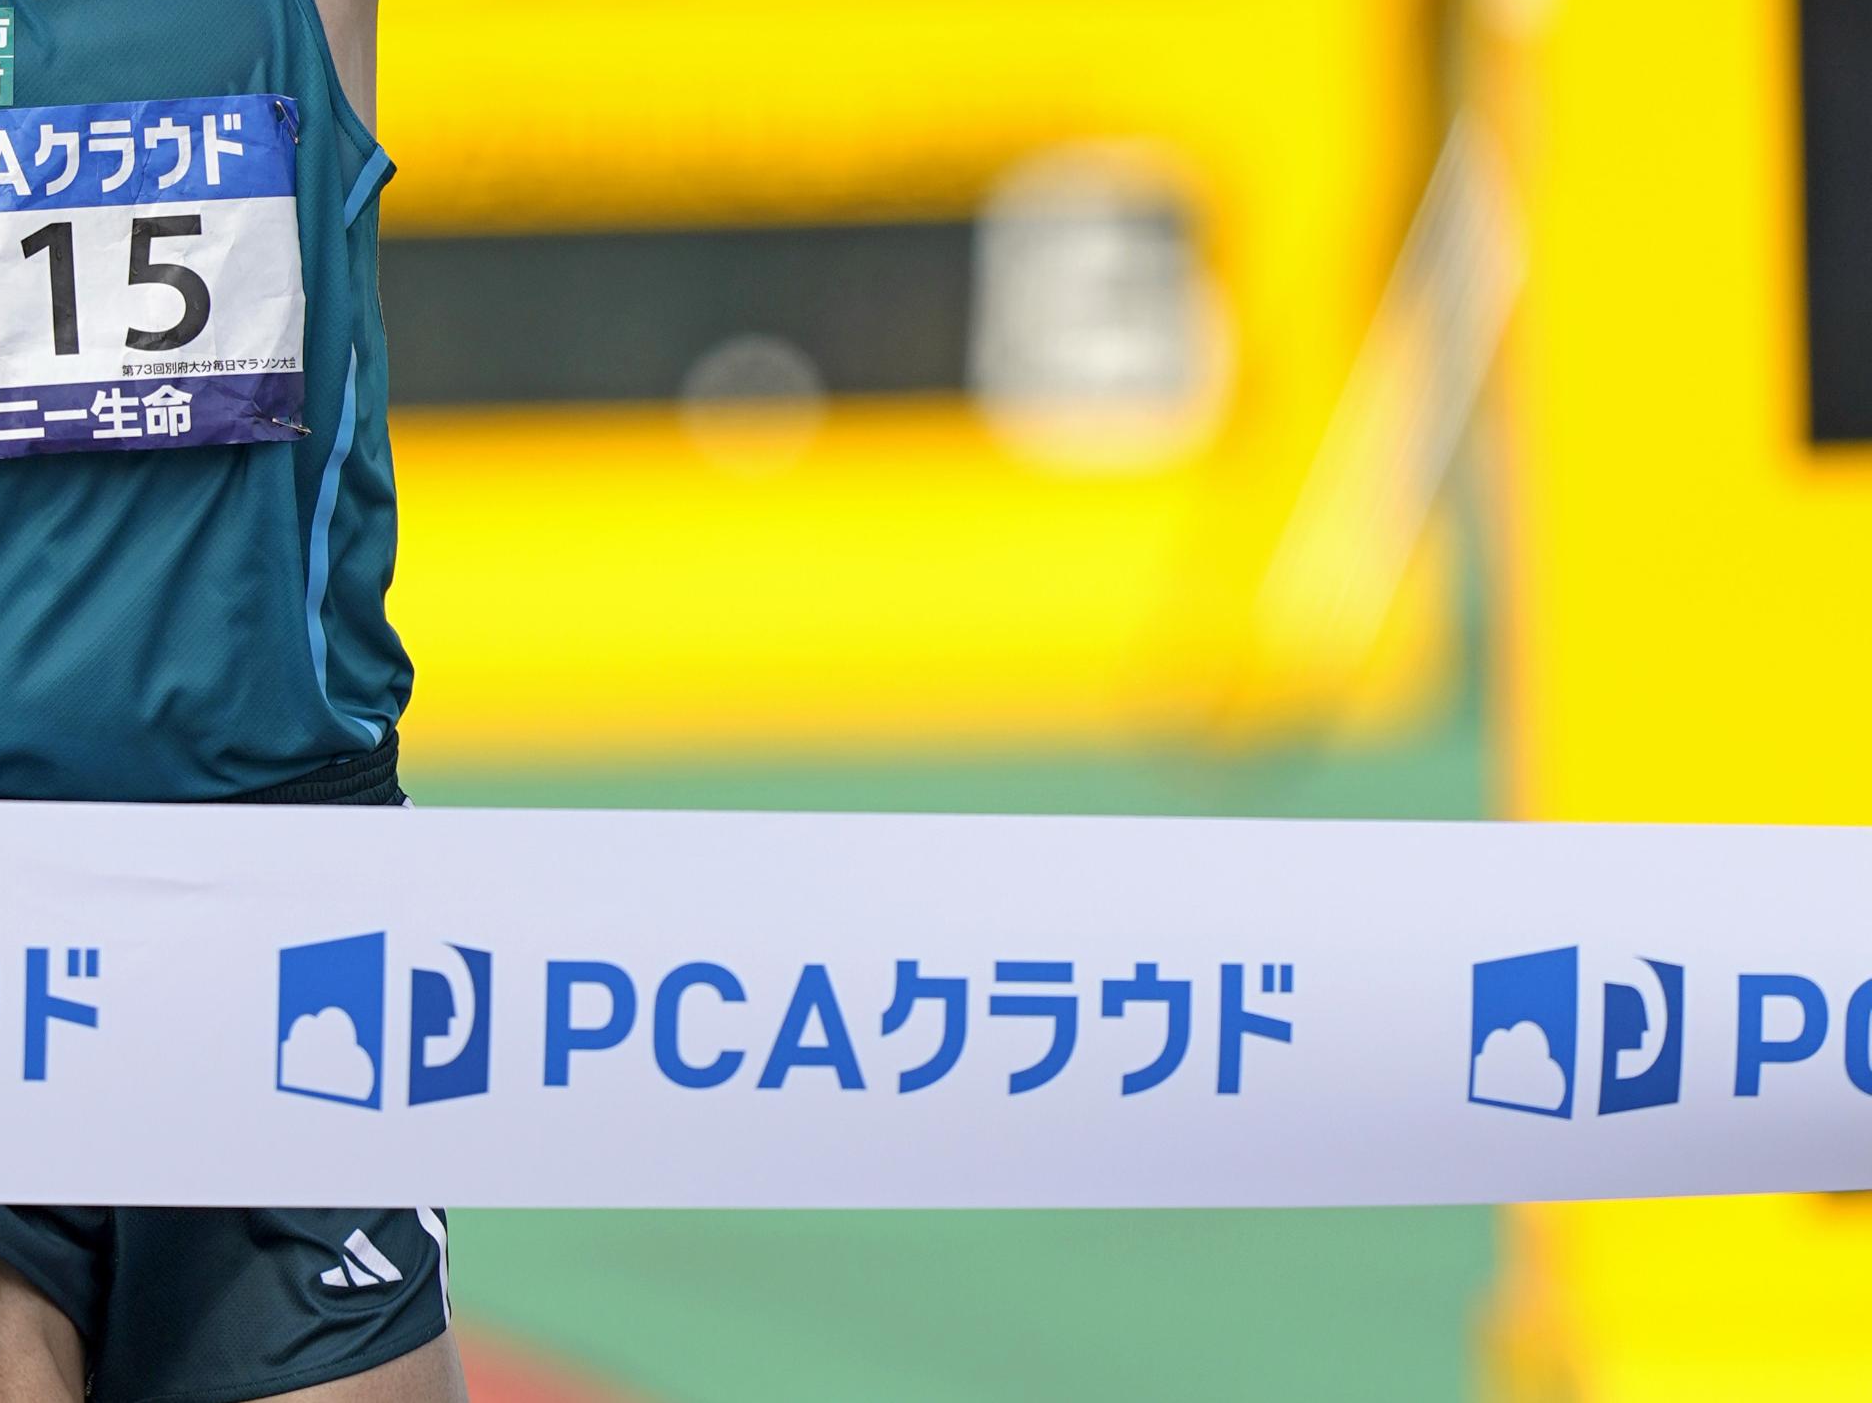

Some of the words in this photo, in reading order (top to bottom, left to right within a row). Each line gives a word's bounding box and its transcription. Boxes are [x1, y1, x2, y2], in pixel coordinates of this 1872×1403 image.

[122, 356, 297, 377] 第73回別府大分毎日マラソン大会
[542, 959, 1294, 1097] PCAクラウド
